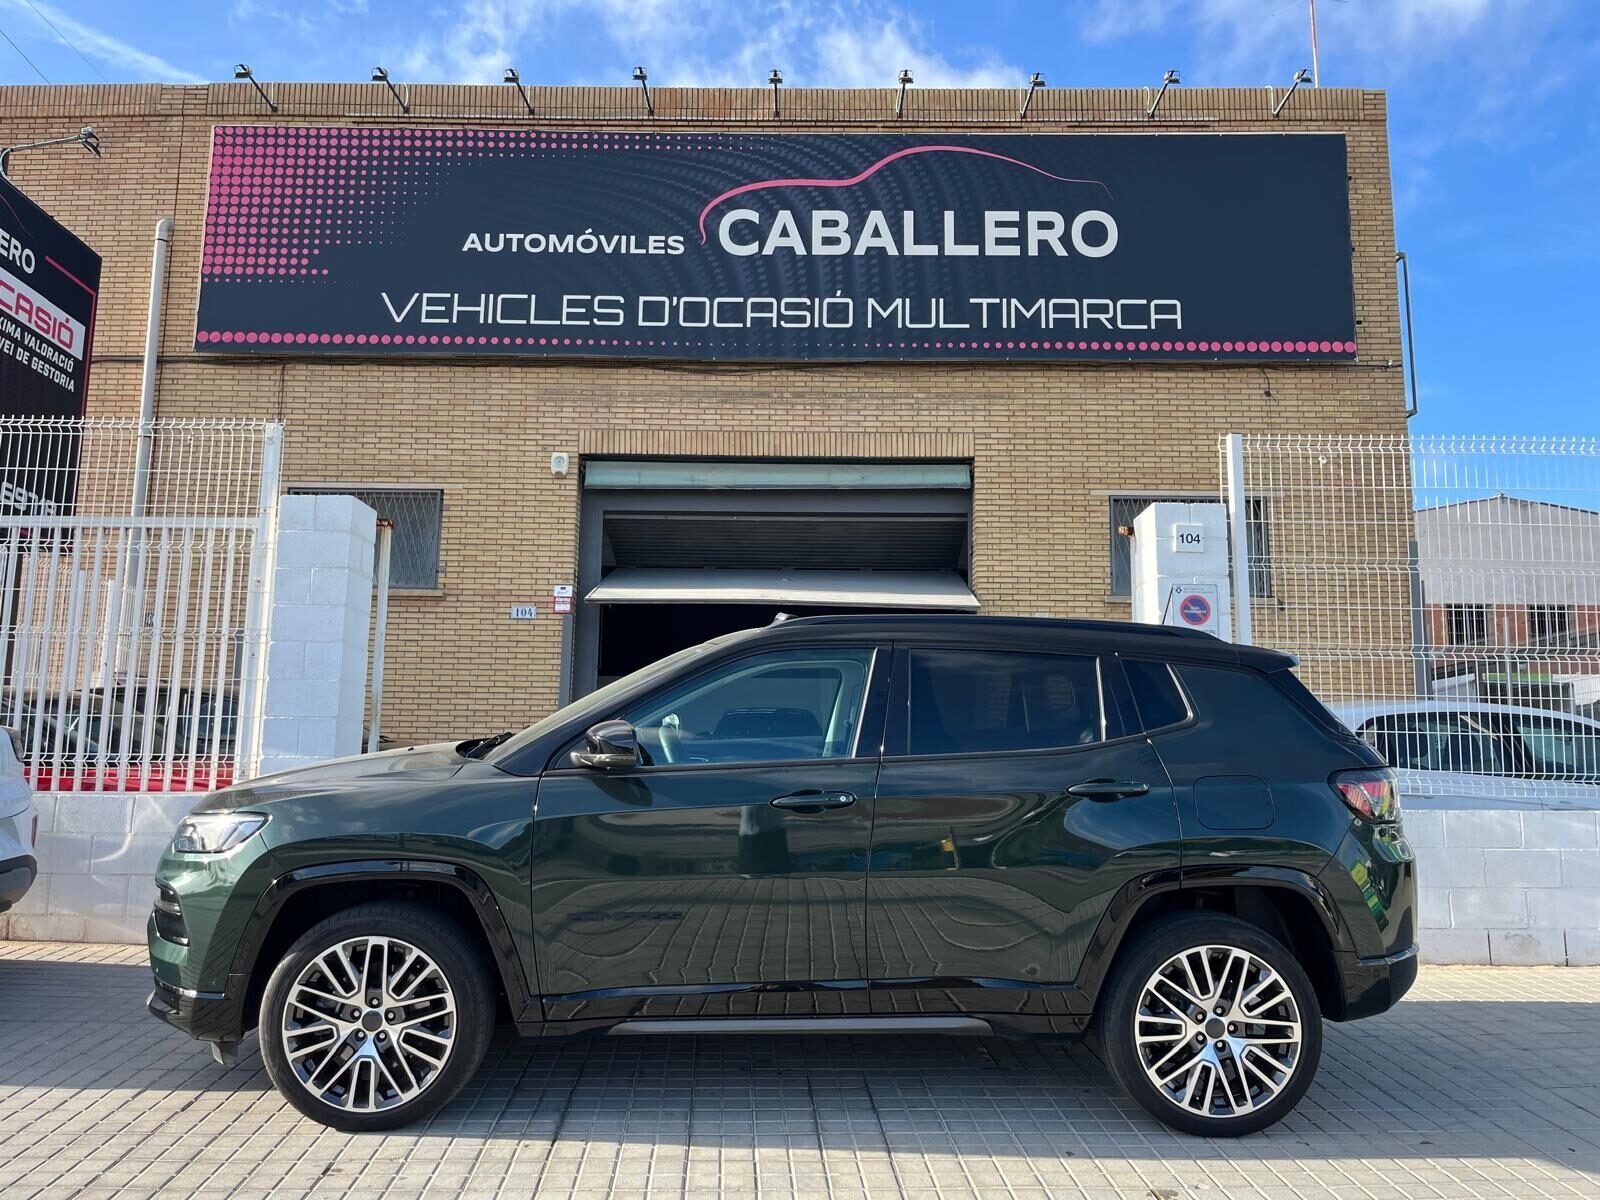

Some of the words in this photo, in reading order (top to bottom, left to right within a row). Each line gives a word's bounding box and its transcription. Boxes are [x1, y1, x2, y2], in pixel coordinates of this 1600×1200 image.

[462, 228, 685, 256] AUTOMÓVILES
[718, 208, 1119, 258] CABALLERO
[381, 293, 625, 326] VEHICLES
[637, 290, 854, 328] D'OCASIÓ
[867, 297, 1182, 330] MULTIMARCA
[15, 346, 30, 365] DE
[31, 356, 75, 393] GESTORIA
[24, 331, 74, 373] VALORACIÓ
[1179, 533, 1201, 544] 104
[515, 607, 533, 617] 104
